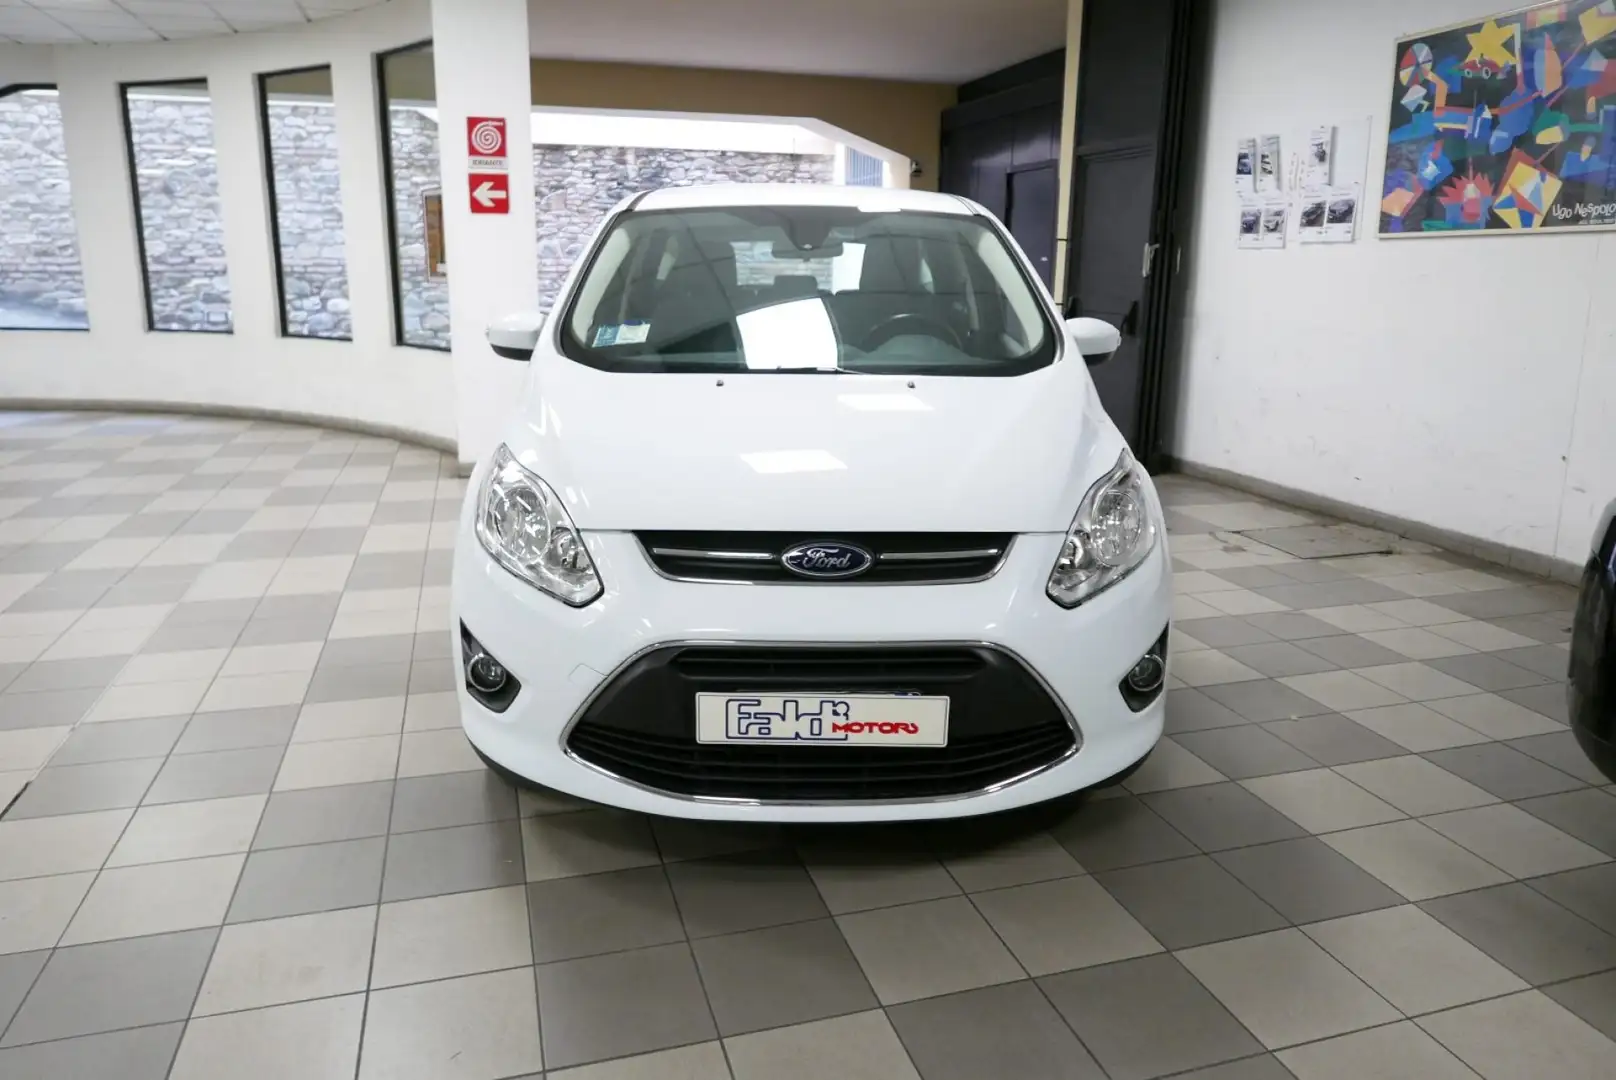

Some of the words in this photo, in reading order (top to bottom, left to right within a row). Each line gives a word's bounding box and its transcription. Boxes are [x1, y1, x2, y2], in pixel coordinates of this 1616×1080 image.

[1552, 203, 1572, 219] Ugo
[802, 547, 852, 568] Ford
[832, 722, 919, 734] MOTORS
